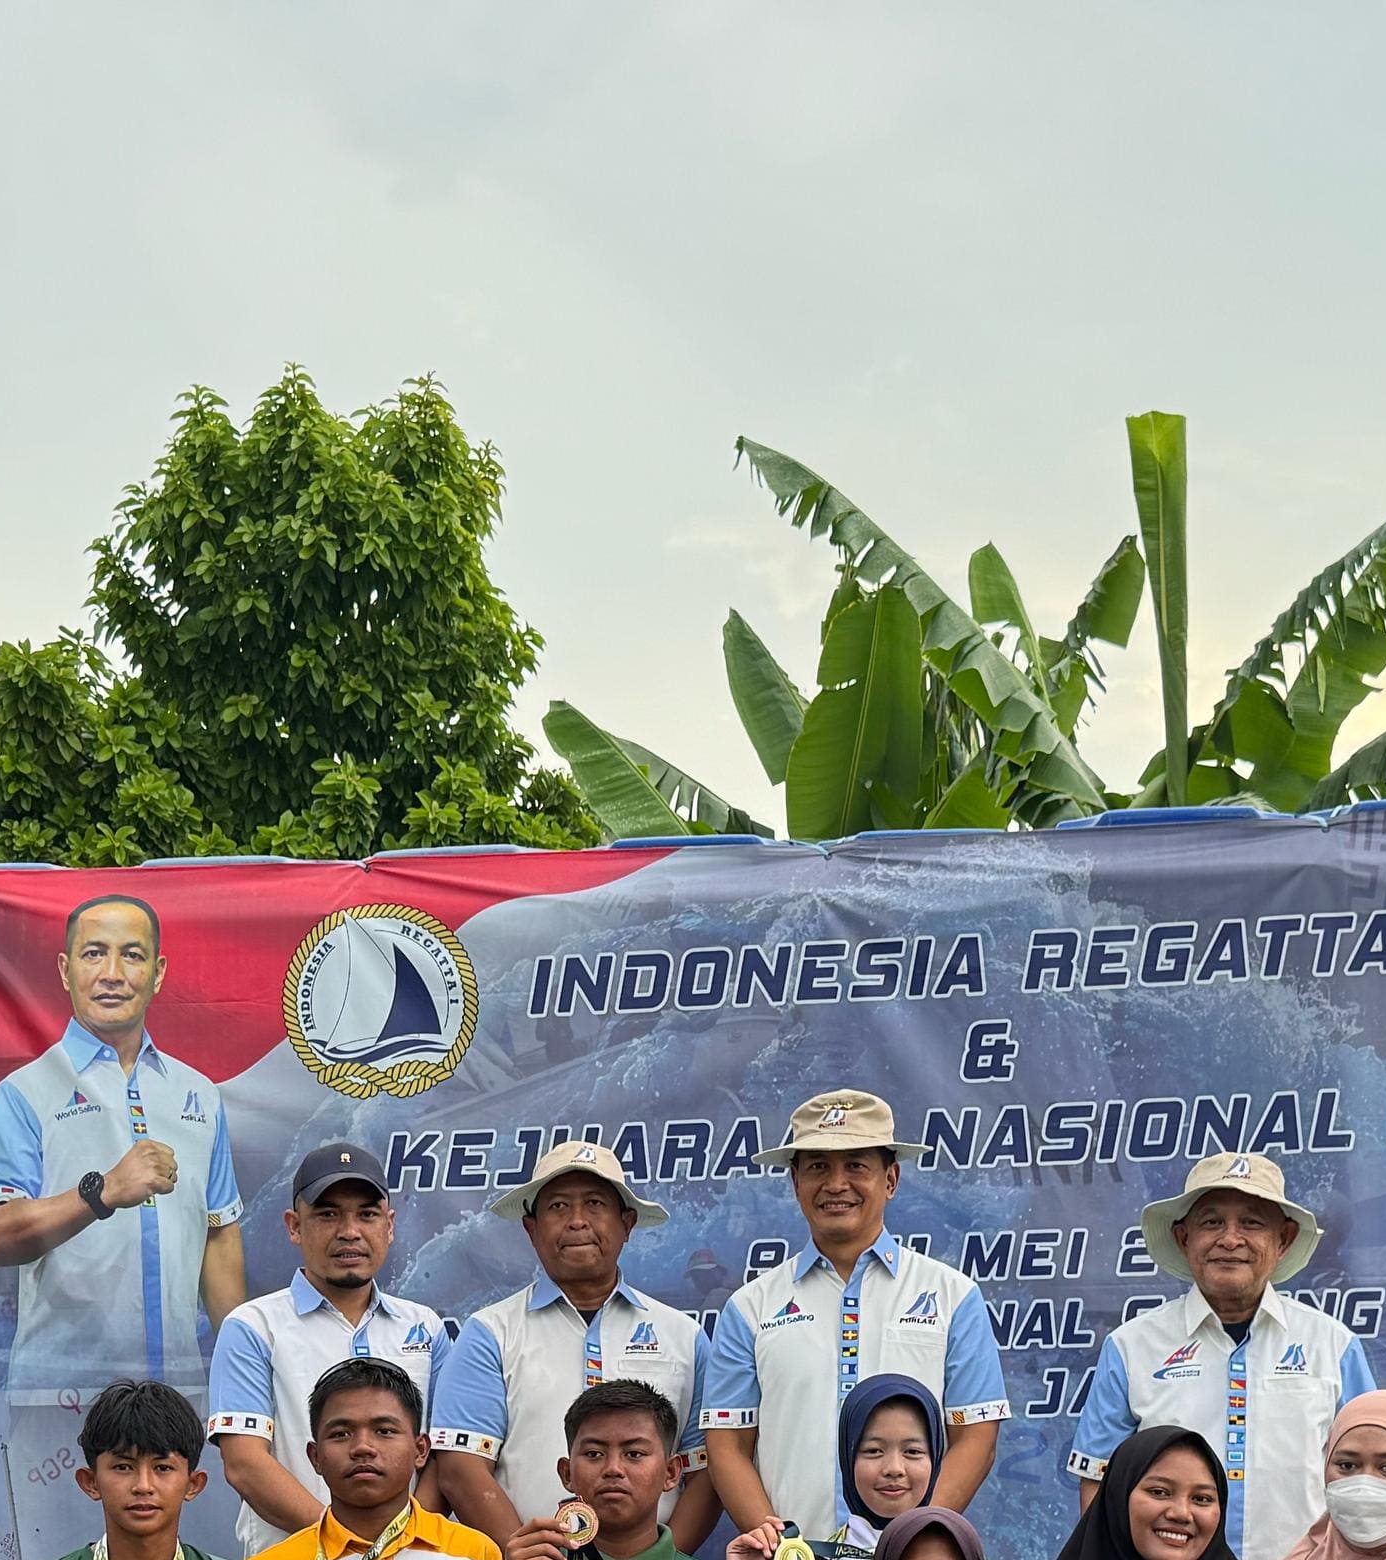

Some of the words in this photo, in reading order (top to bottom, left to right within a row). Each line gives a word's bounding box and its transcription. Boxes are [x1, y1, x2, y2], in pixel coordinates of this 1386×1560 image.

[301, 940, 336, 1032] INDONESIA
[400, 924, 457, 992] REGATTA
[527, 933, 987, 1019] INDONESIA
[959, 1018, 1018, 1083] &
[917, 1088, 1354, 1171] NASIONAL
[959, 1228, 1088, 1281] MEI
[760, 1318, 785, 1330] World
[786, 1312, 814, 1324] Sailing
